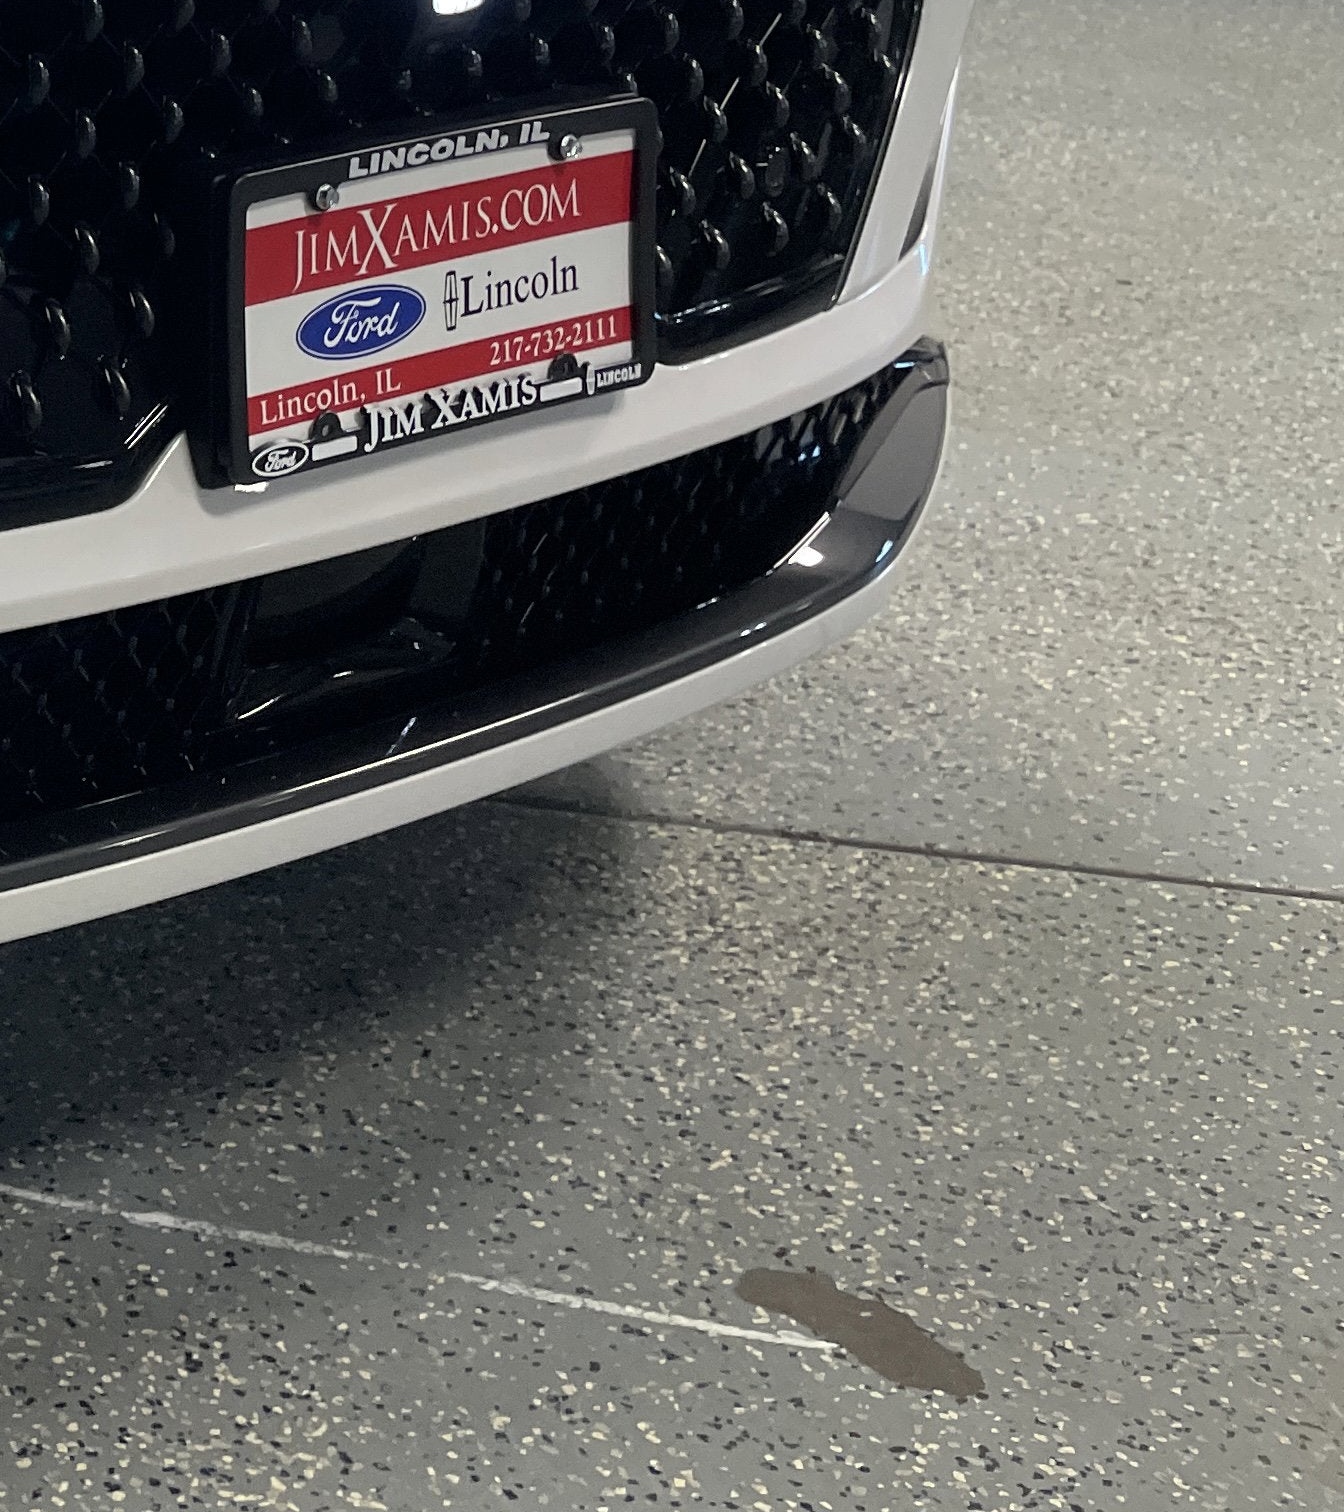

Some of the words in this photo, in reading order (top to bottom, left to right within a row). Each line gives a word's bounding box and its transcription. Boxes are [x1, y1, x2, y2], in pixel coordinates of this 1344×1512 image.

[349, 128, 509, 179] LINCOLN,
[519, 121, 551, 143] IL
[460, 256, 579, 318] Lincoln
[323, 296, 399, 349] Ford
[489, 315, 618, 367] 217-732-2111
[260, 378, 366, 425] Lincoln,
[376, 368, 402, 396] IL
[364, 404, 423, 453] JIM
[430, 377, 539, 430] XAMIS
[264, 448, 297, 472] Ford
